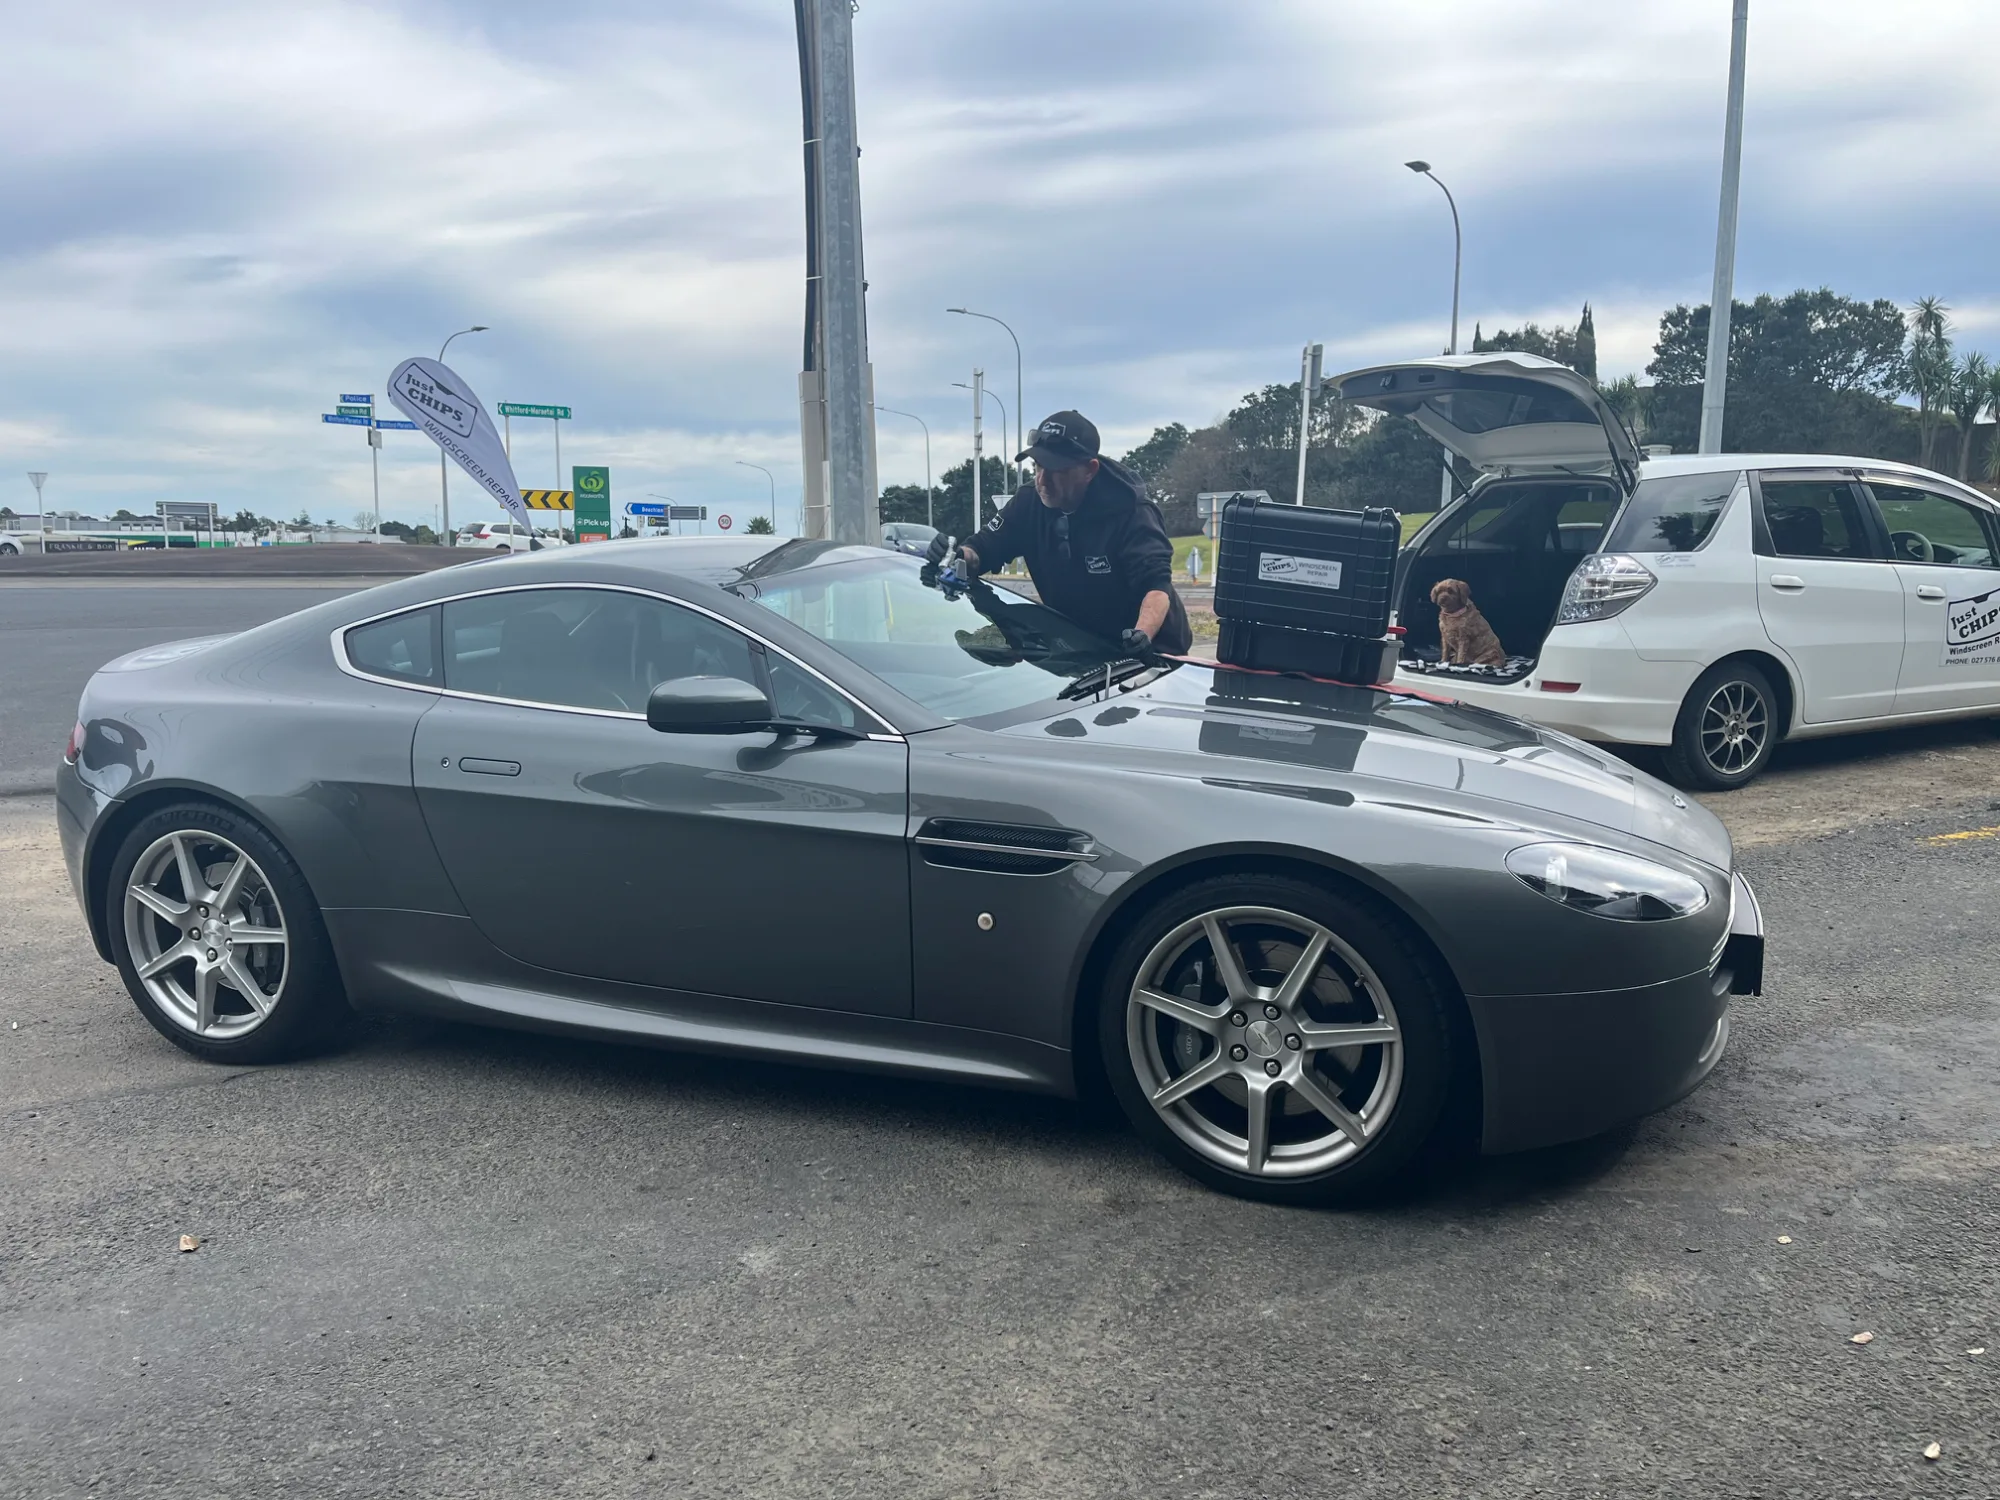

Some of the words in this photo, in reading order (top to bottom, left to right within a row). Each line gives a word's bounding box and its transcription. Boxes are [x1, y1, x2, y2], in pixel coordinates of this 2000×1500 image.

[405, 373, 434, 394] Just
[408, 387, 463, 421] CHIPS
[556, 408, 565, 416] Rd
[424, 420, 487, 478] WINDSCREEN
[485, 477, 519, 510] REPAIR
[1267, 562, 1291, 572] CHIPS
[1298, 562, 1338, 571] WINDSCREEN
[1950, 606, 1977, 630] Just
[1949, 640, 1993, 655] Windscreen
